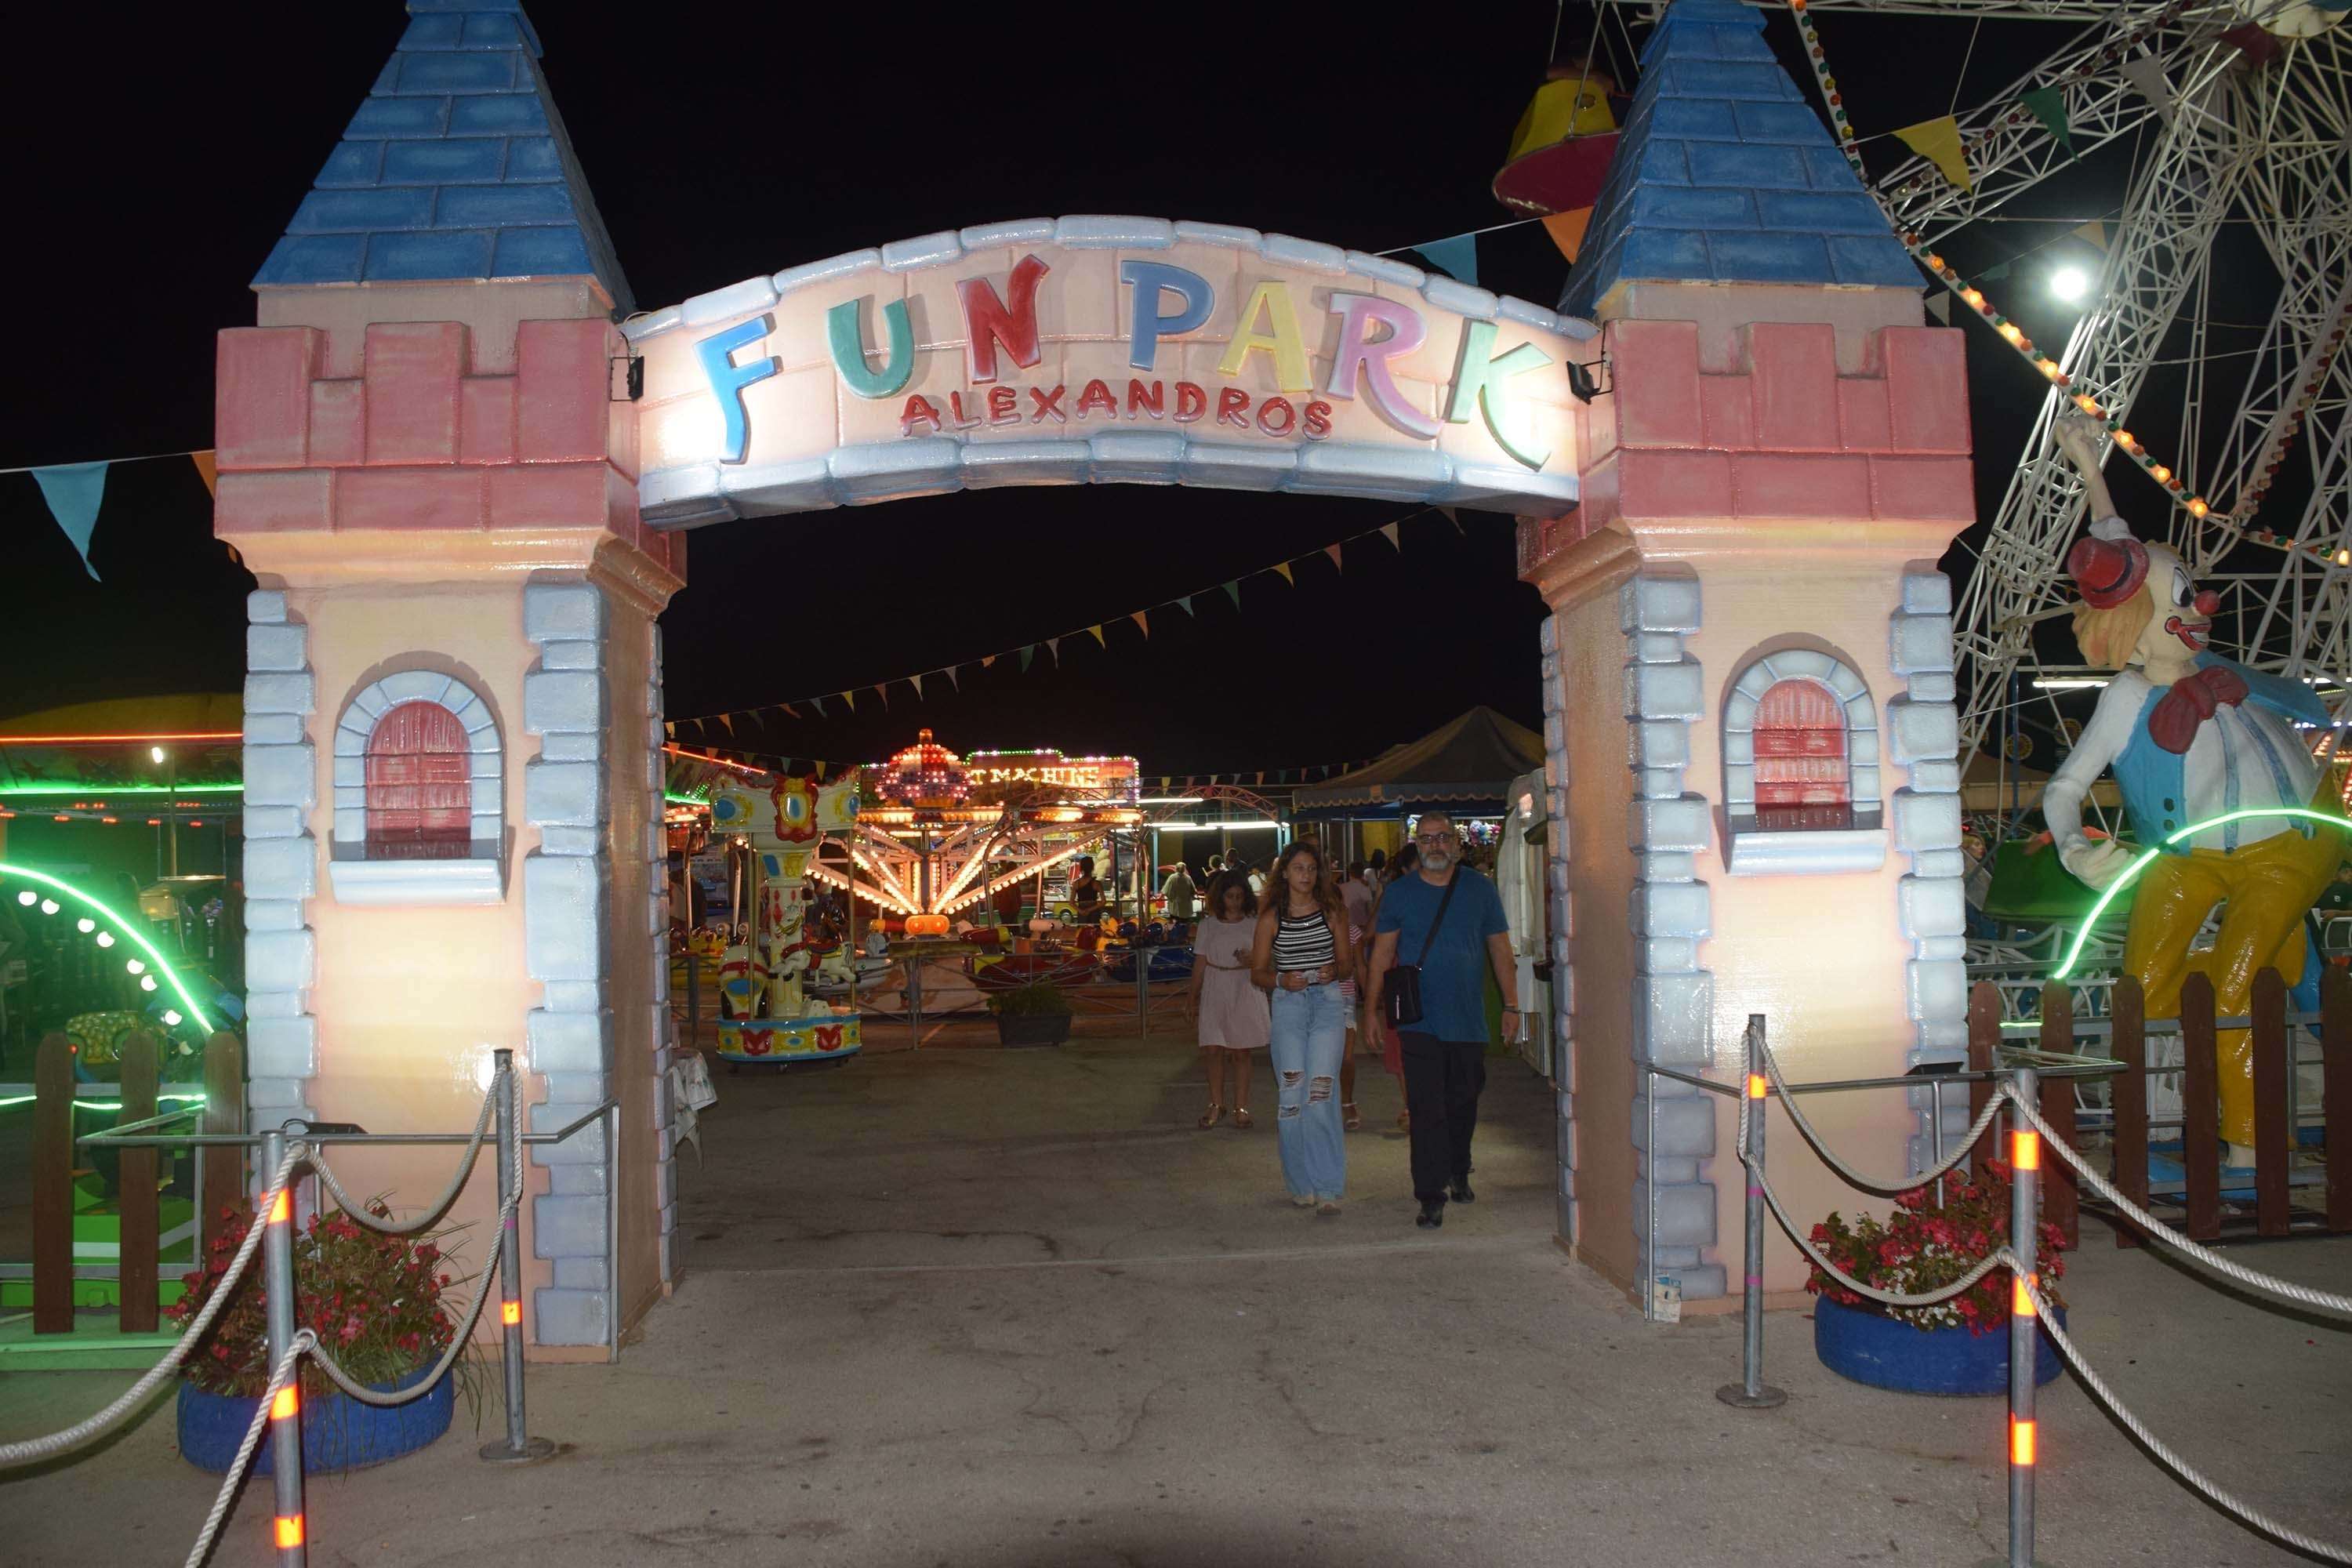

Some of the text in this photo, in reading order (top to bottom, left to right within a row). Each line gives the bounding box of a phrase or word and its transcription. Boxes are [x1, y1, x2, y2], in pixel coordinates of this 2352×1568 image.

[693, 254, 1553, 472] FUN PARK
[899, 378, 1333, 441] ALEXANDROS
[989, 766, 1100, 788] MACHINE
